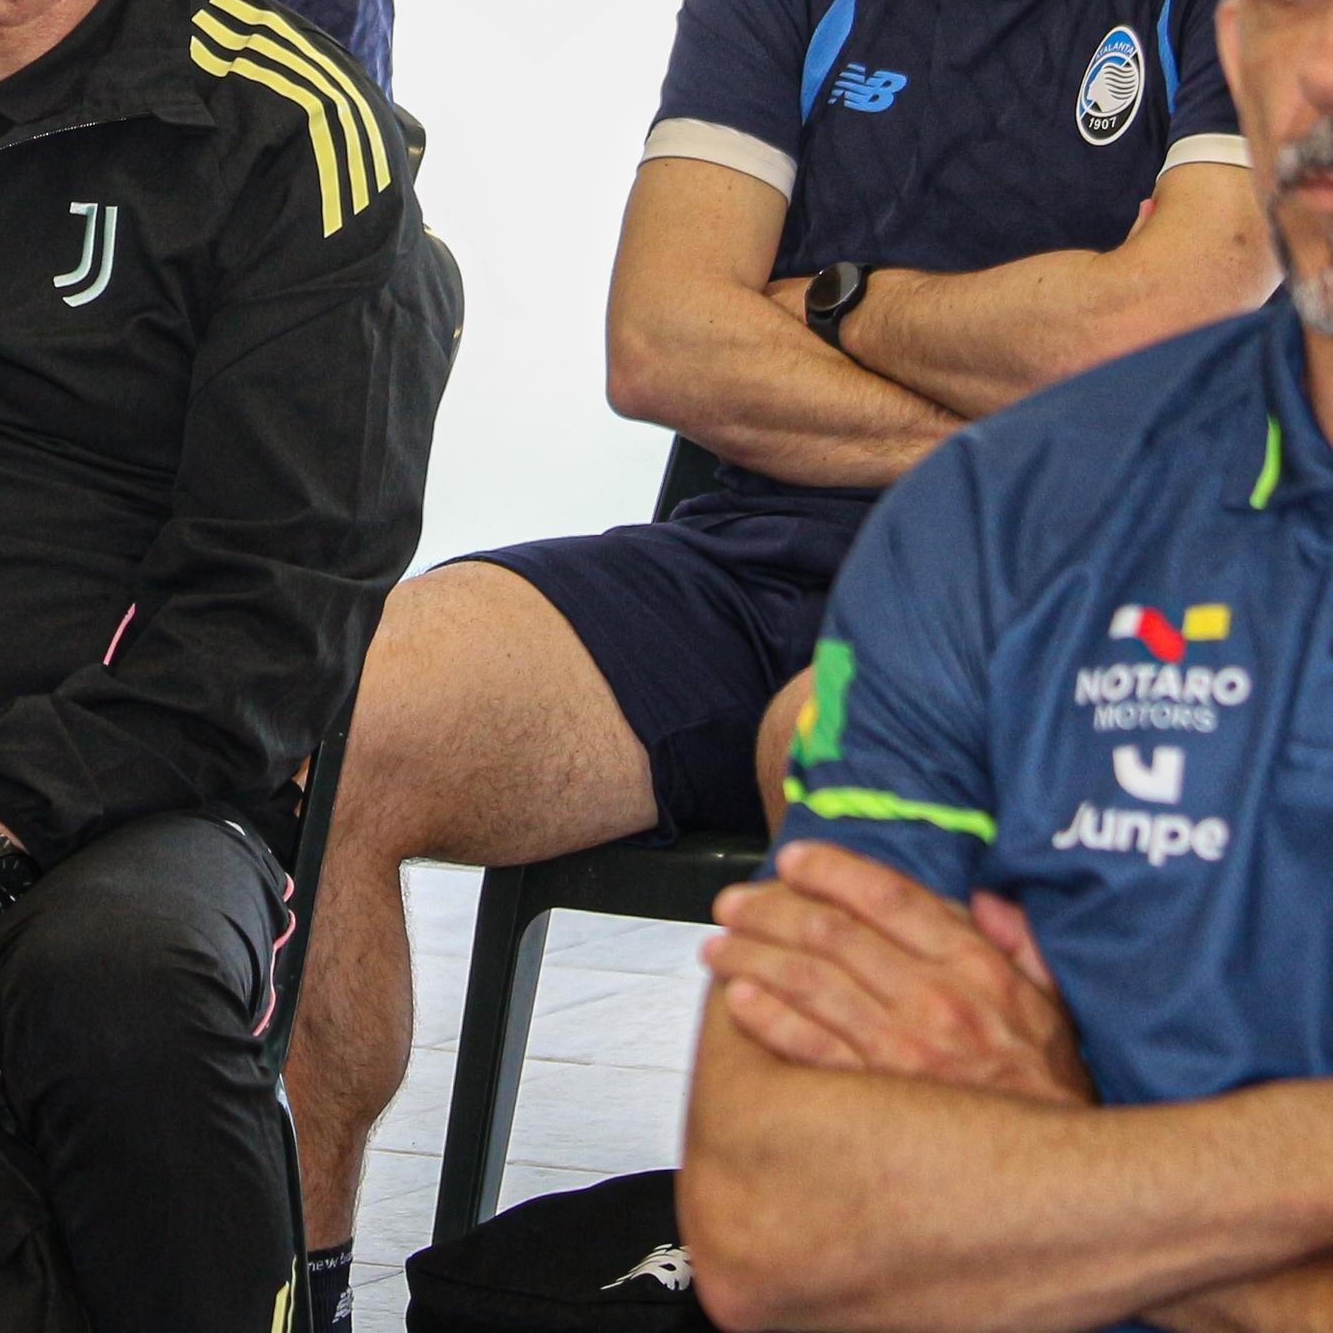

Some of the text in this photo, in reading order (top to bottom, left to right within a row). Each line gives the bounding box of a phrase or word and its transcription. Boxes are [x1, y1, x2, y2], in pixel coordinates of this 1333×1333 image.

[1088, 116, 1117, 130] 1907
[1074, 663, 1252, 706] NOTARO
[1093, 701, 1218, 733] MOTORS
[1052, 800, 1230, 867] Junpe
